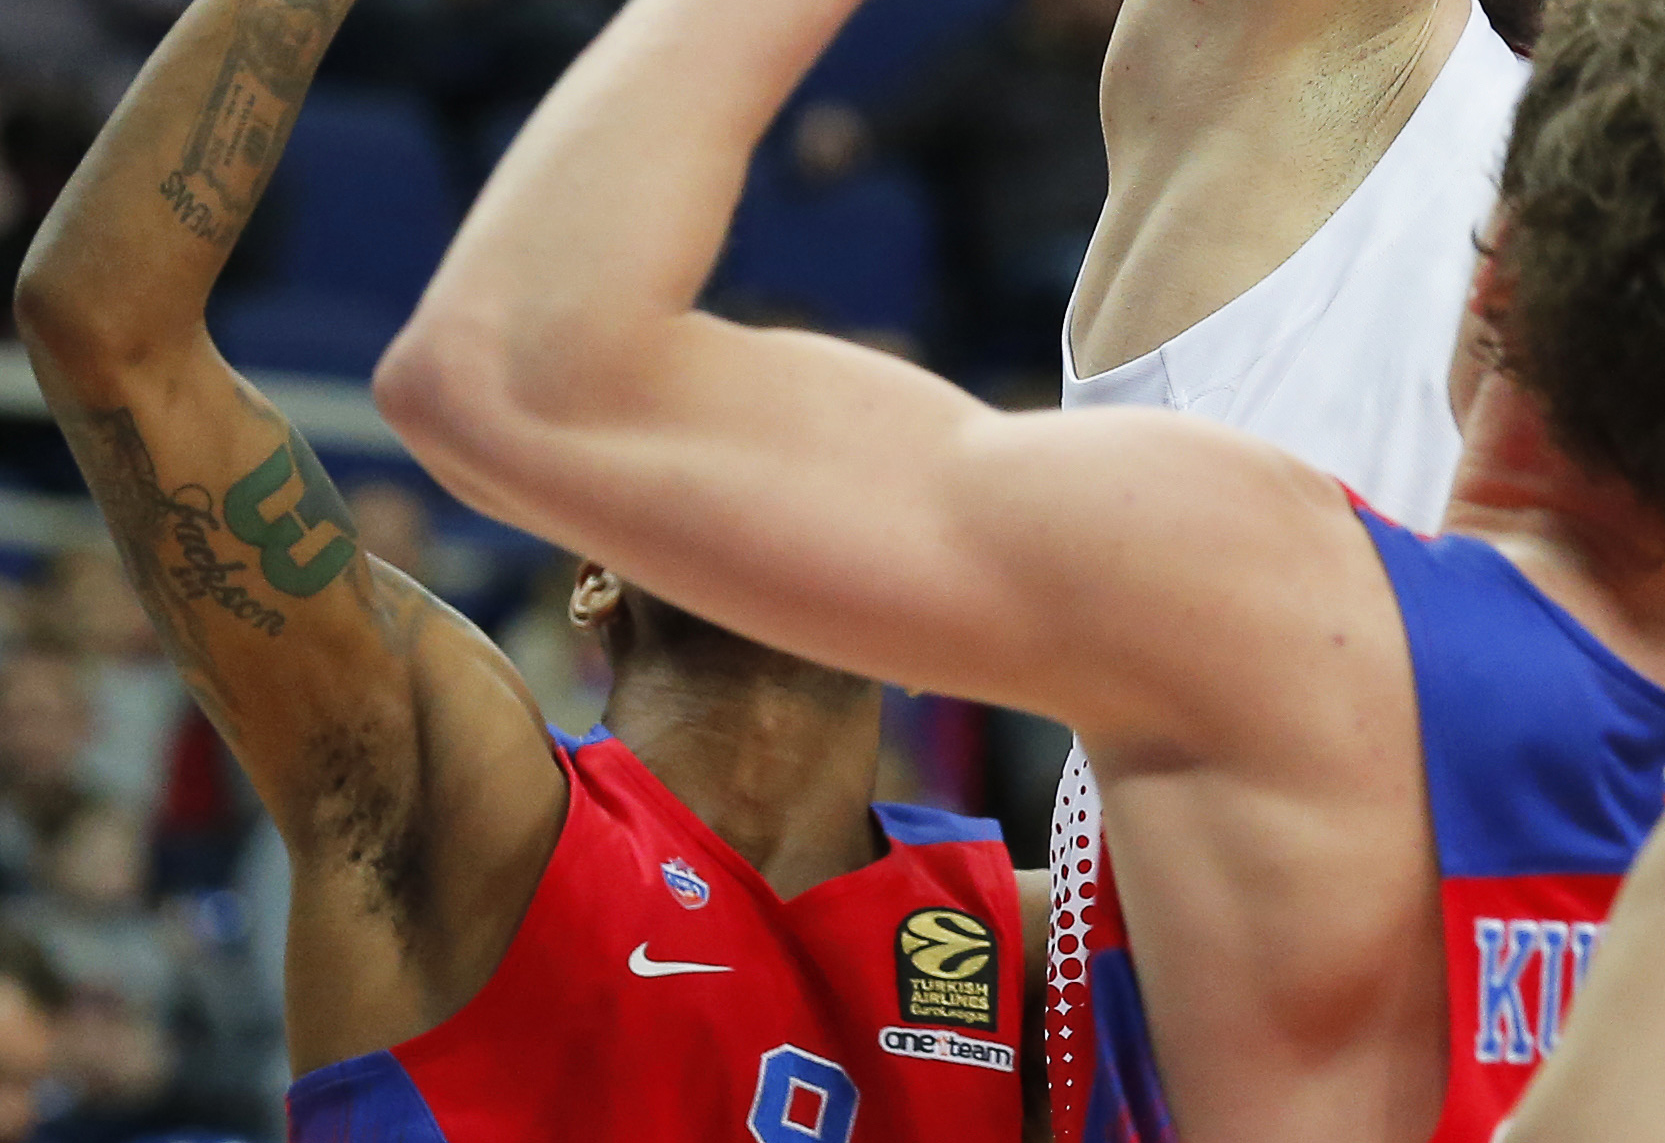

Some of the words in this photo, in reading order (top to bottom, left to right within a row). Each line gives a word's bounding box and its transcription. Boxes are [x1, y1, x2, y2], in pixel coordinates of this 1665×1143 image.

[909, 978, 989, 996] TURKISH
[910, 990, 990, 1010] AIRLINES
[1474, 917, 1610, 1064] KU
[885, 1031, 937, 1053] one
[947, 1036, 1011, 1066] team
